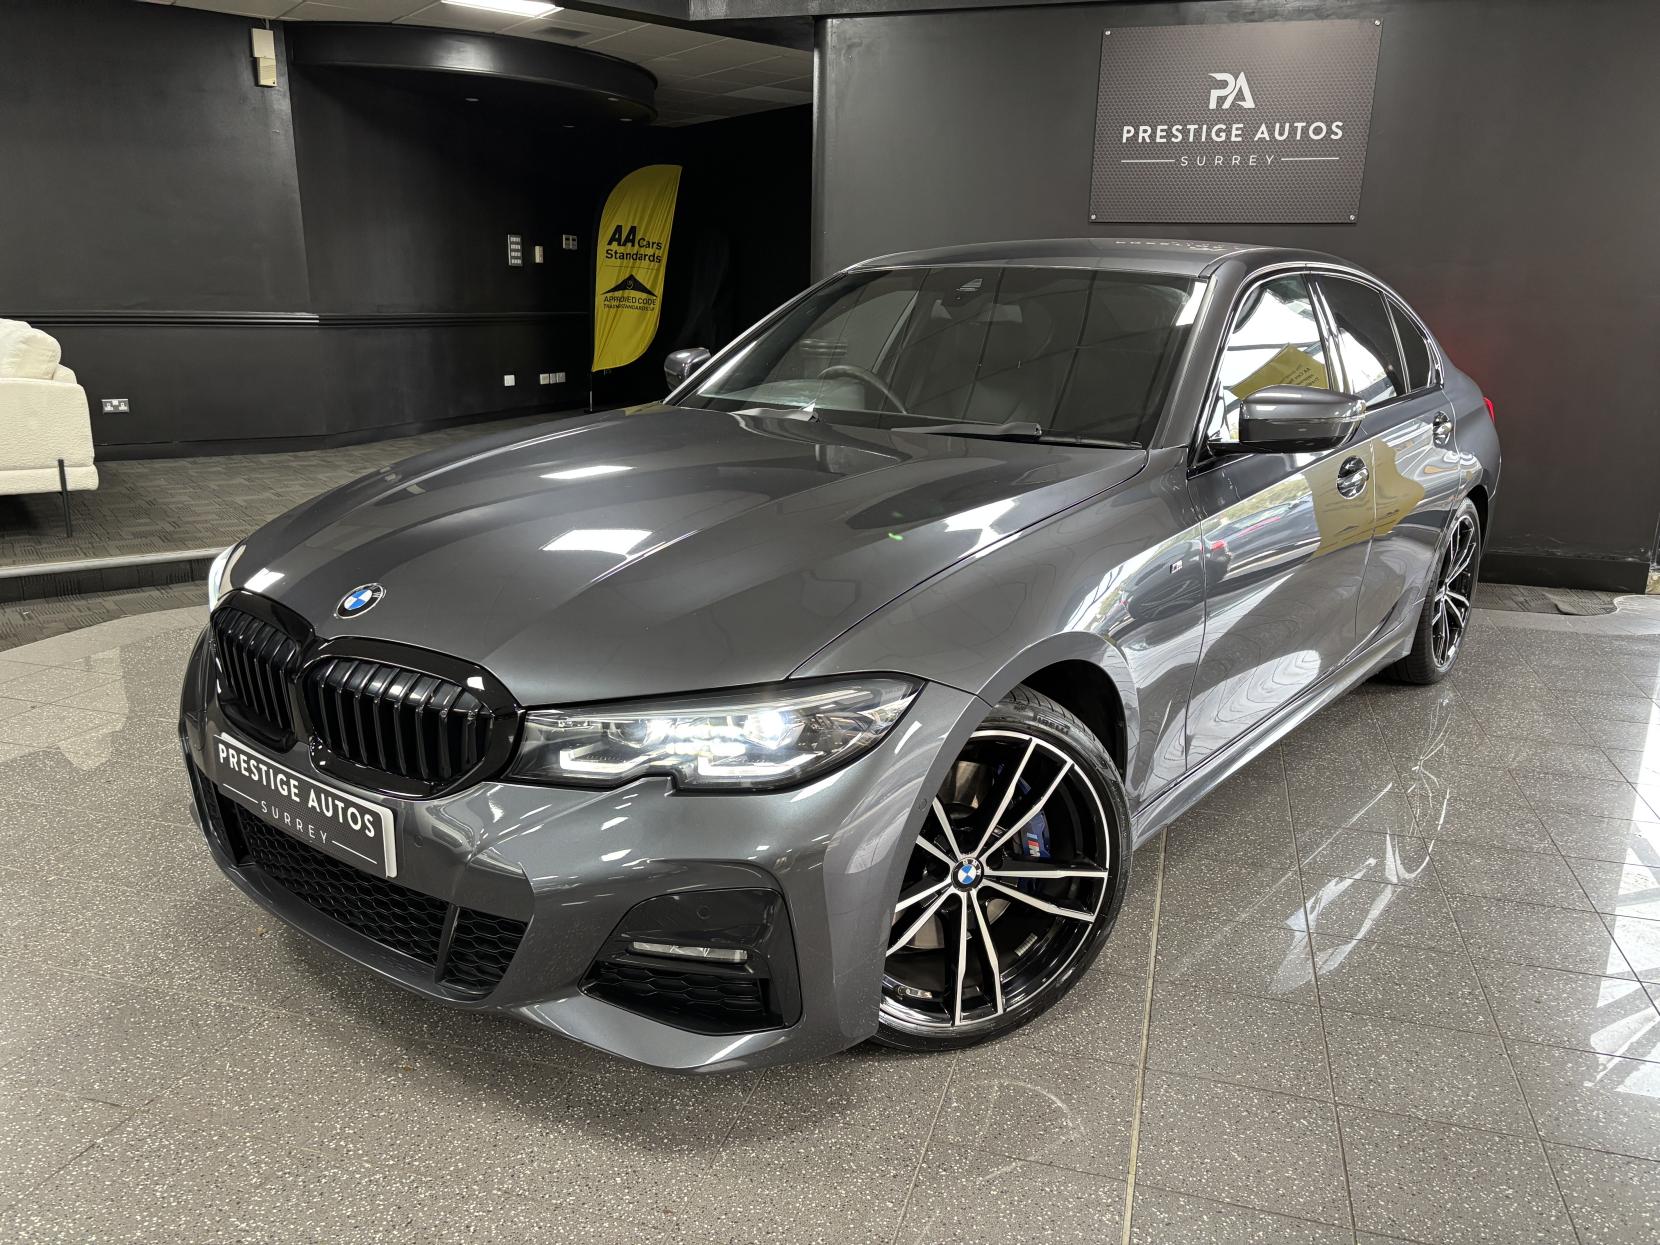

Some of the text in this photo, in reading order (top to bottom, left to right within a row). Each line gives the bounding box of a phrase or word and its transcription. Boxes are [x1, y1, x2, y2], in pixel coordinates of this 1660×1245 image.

[1122, 121, 1344, 144] PRESTIGE AUTOS
[1180, 154, 1275, 167] SURREY
[607, 224, 663, 250] AA Cars
[605, 249, 663, 263] Standards
[637, 297, 657, 306] CODE
[218, 743, 375, 838] PRESTIGE AUTOS
[261, 800, 328, 844] SURREY
